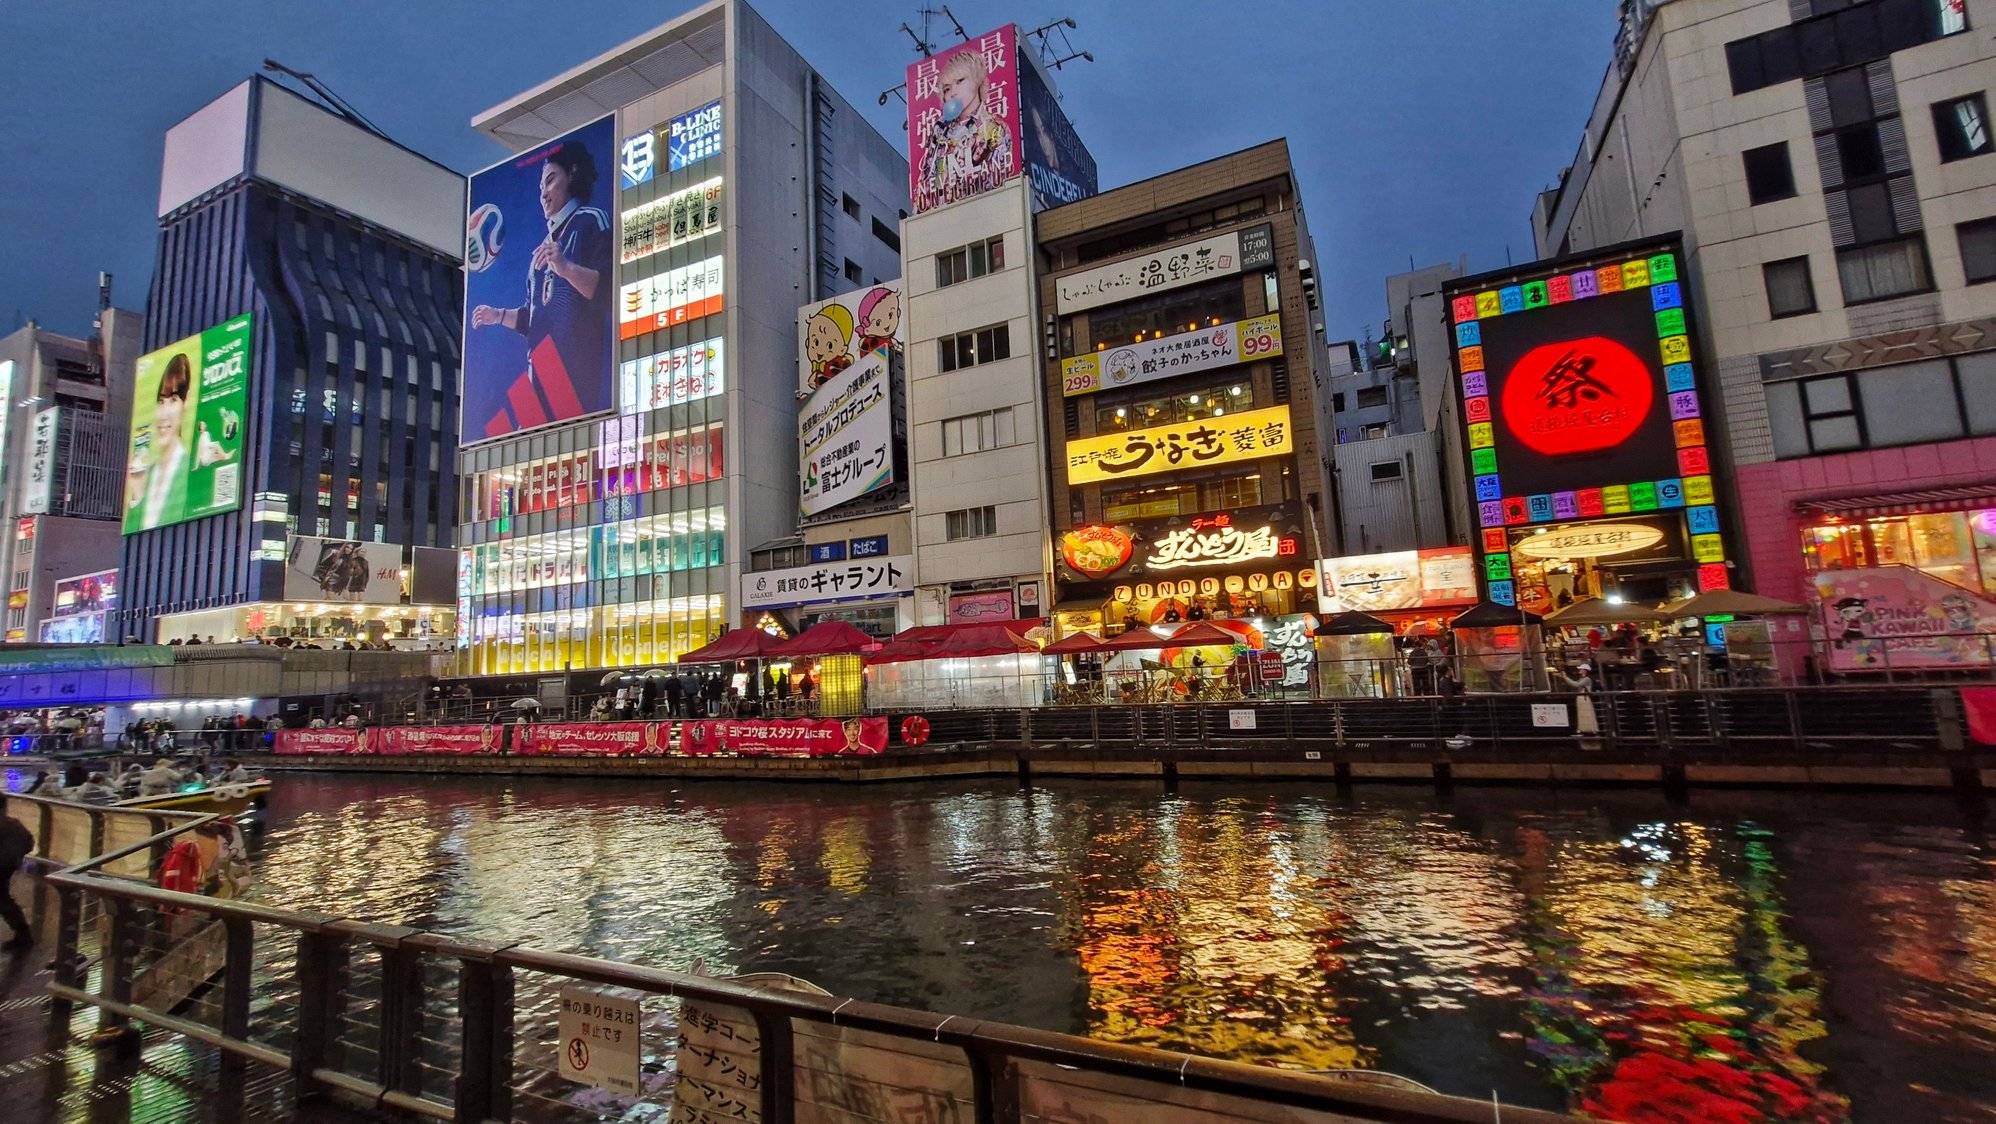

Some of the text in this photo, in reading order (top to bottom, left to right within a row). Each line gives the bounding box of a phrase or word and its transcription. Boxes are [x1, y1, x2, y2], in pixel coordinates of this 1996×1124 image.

[981, 32, 1009, 119] 最高
[915, 59, 943, 149] 最強
[672, 105, 721, 137] B-LINE
[680, 119, 721, 143] CLINIC
[705, 185, 721, 201] 6F
[1244, 238, 1267, 251] 17:00
[1242, 324, 1278, 337] ハイボール
[658, 349, 706, 374] カラオケ
[1066, 363, 1094, 375] 生ビール
[1142, 346, 1232, 374] 餃子のかっちゃん
[1535, 348, 1620, 409] 祭
[804, 382, 882, 456] トータルプロデュース
[821, 442, 886, 494] 富士グループ
[820, 546, 830, 560] 酒
[853, 540, 878, 555] たばこ
[1146, 526, 1279, 569] ずんどう屋
[777, 562, 902, 594] 賃貸のギャラント
[1117, 574, 1288, 600] ZUNDO-YA
[1269, 620, 1307, 647] ずん
[1871, 619, 1946, 635] KAWAII
[1283, 663, 1308, 687] 屋
[581, 1022, 623, 1043] 禁止です
